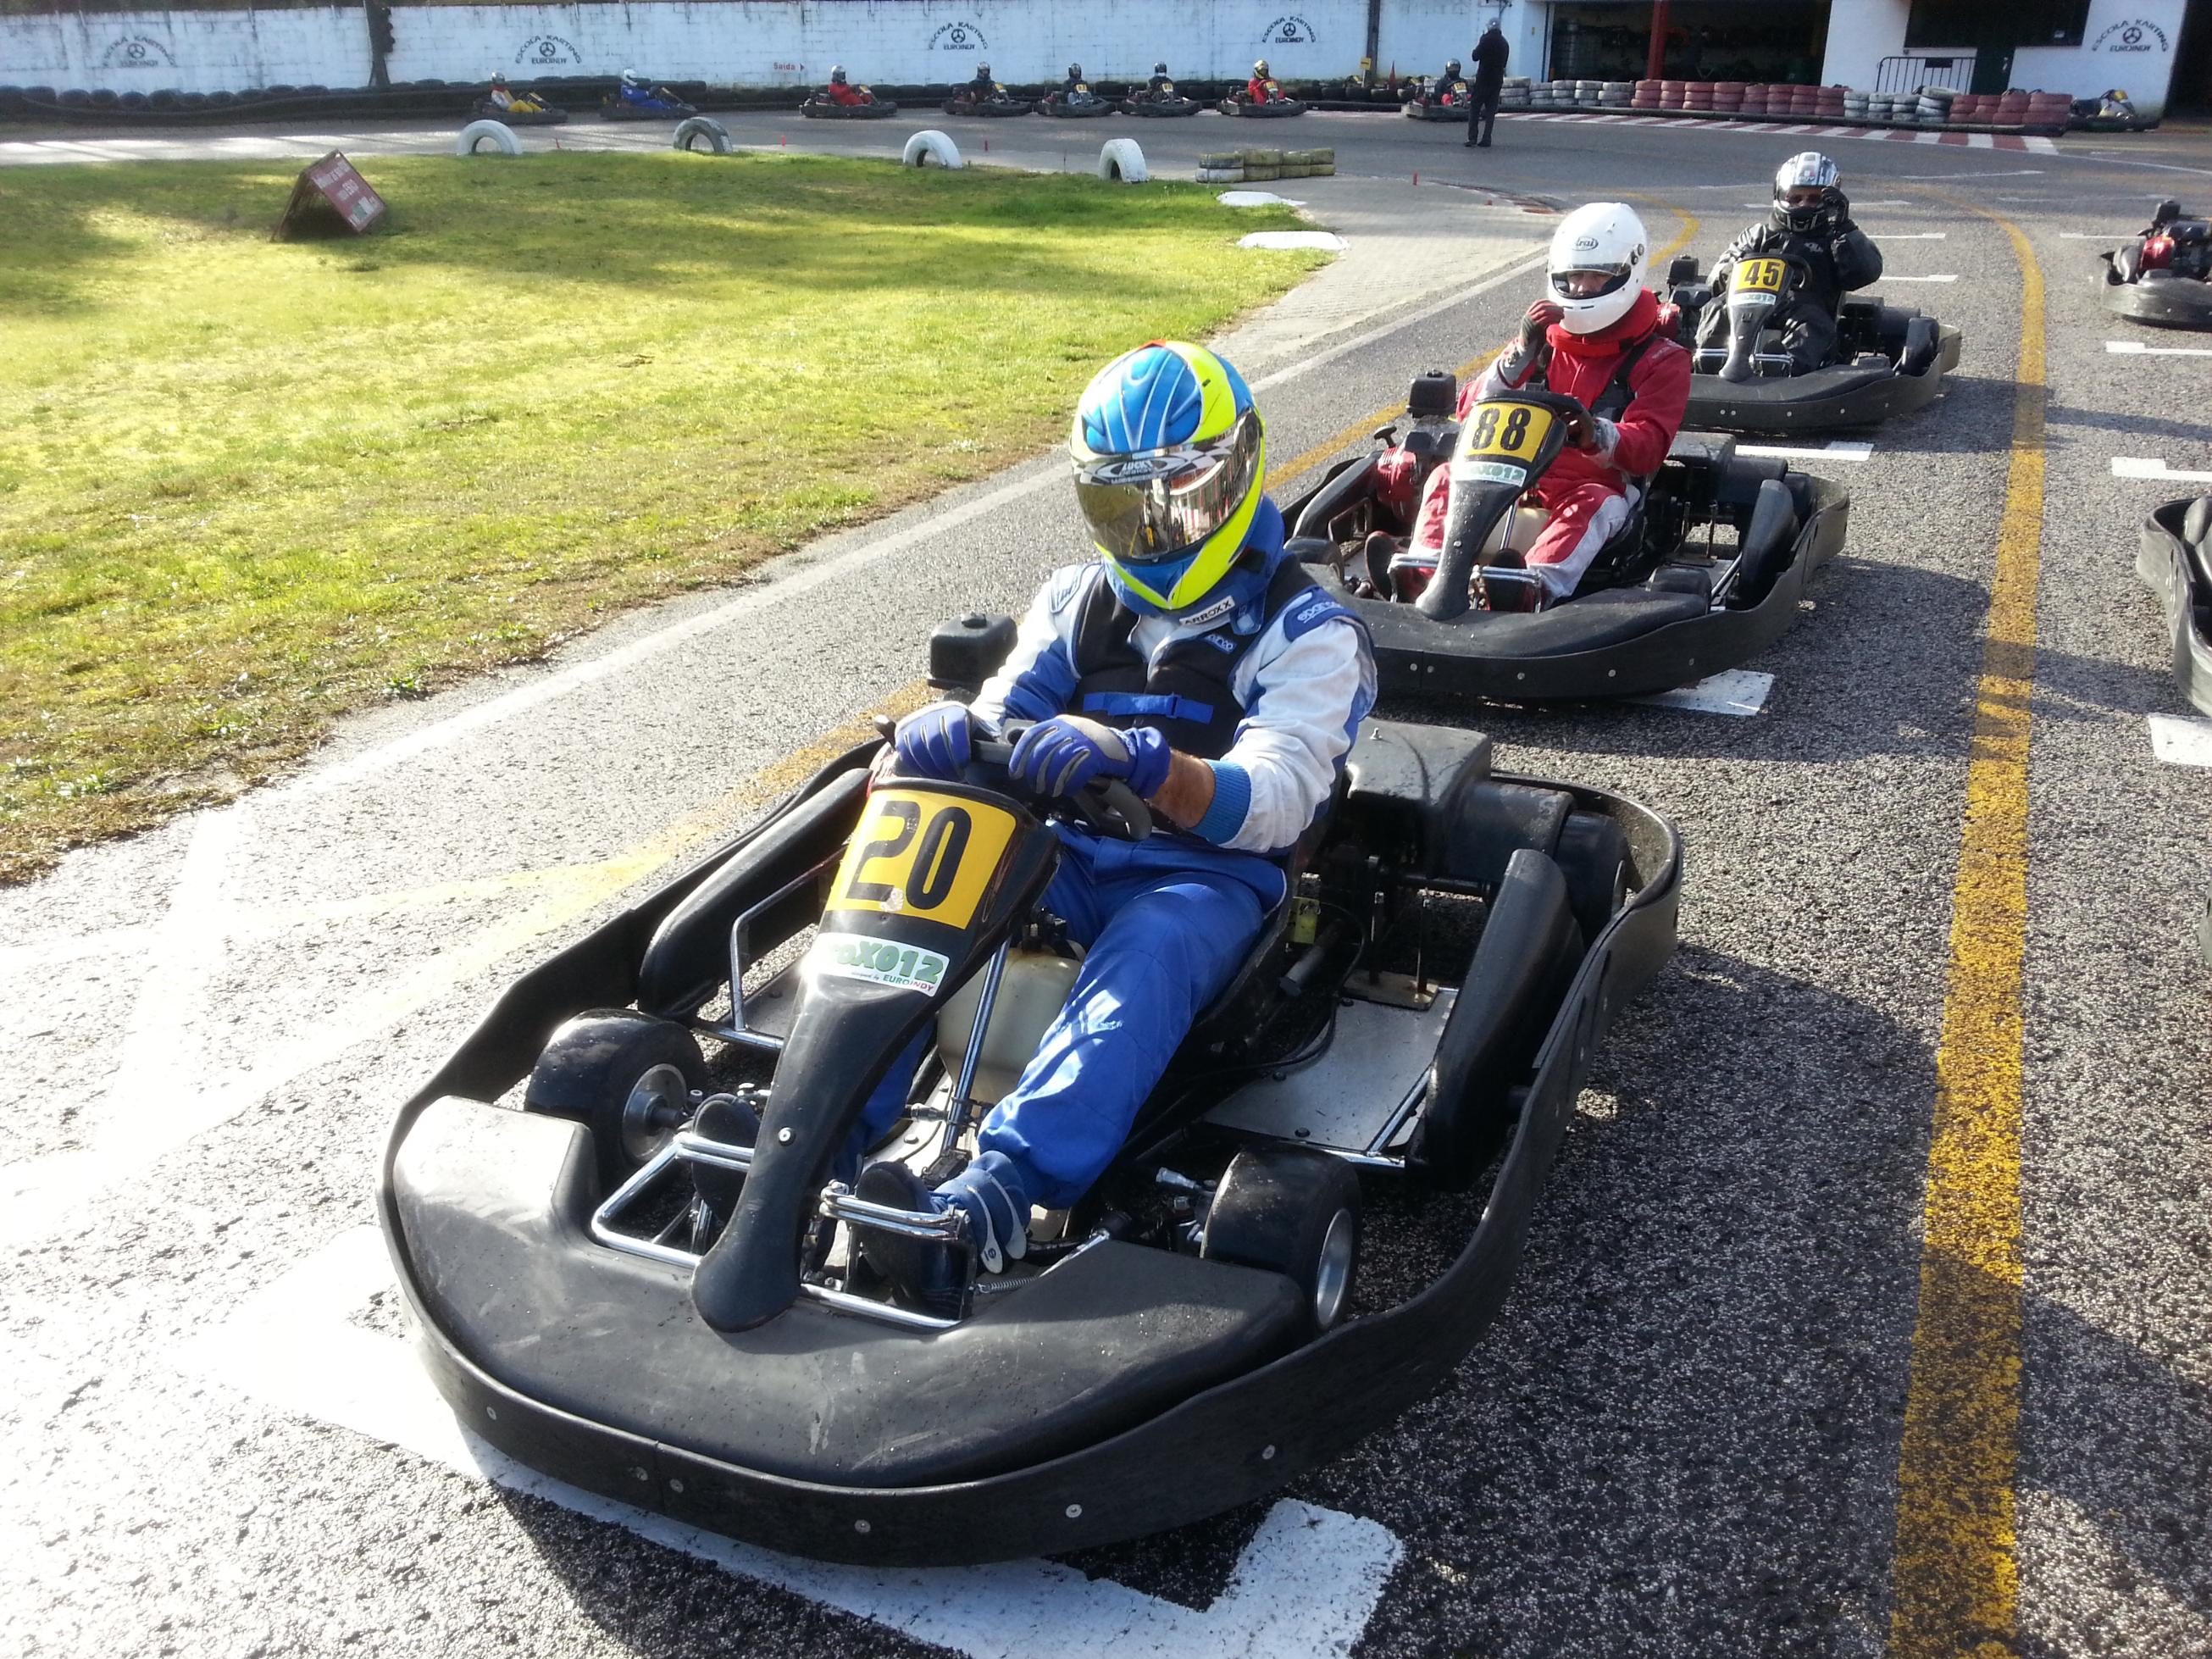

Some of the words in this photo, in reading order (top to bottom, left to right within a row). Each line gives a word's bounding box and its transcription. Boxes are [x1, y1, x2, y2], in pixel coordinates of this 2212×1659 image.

[929, 23, 953, 49] ESCOLA
[958, 22, 988, 49] KARTING
[1261, 17, 1285, 42] ESCOLA
[1289, 16, 1316, 42] KARTING
[2092, 20, 2128, 51] ESCOLA
[2136, 19, 2168, 52] KARTING
[515, 36, 541, 64] ESCOLA
[546, 35, 582, 64] KARTING
[1744, 262, 1781, 286] 45
[1472, 407, 1532, 451] 88
[845, 800, 973, 910] 20
[883, 974, 934, 991] EUROINDY
